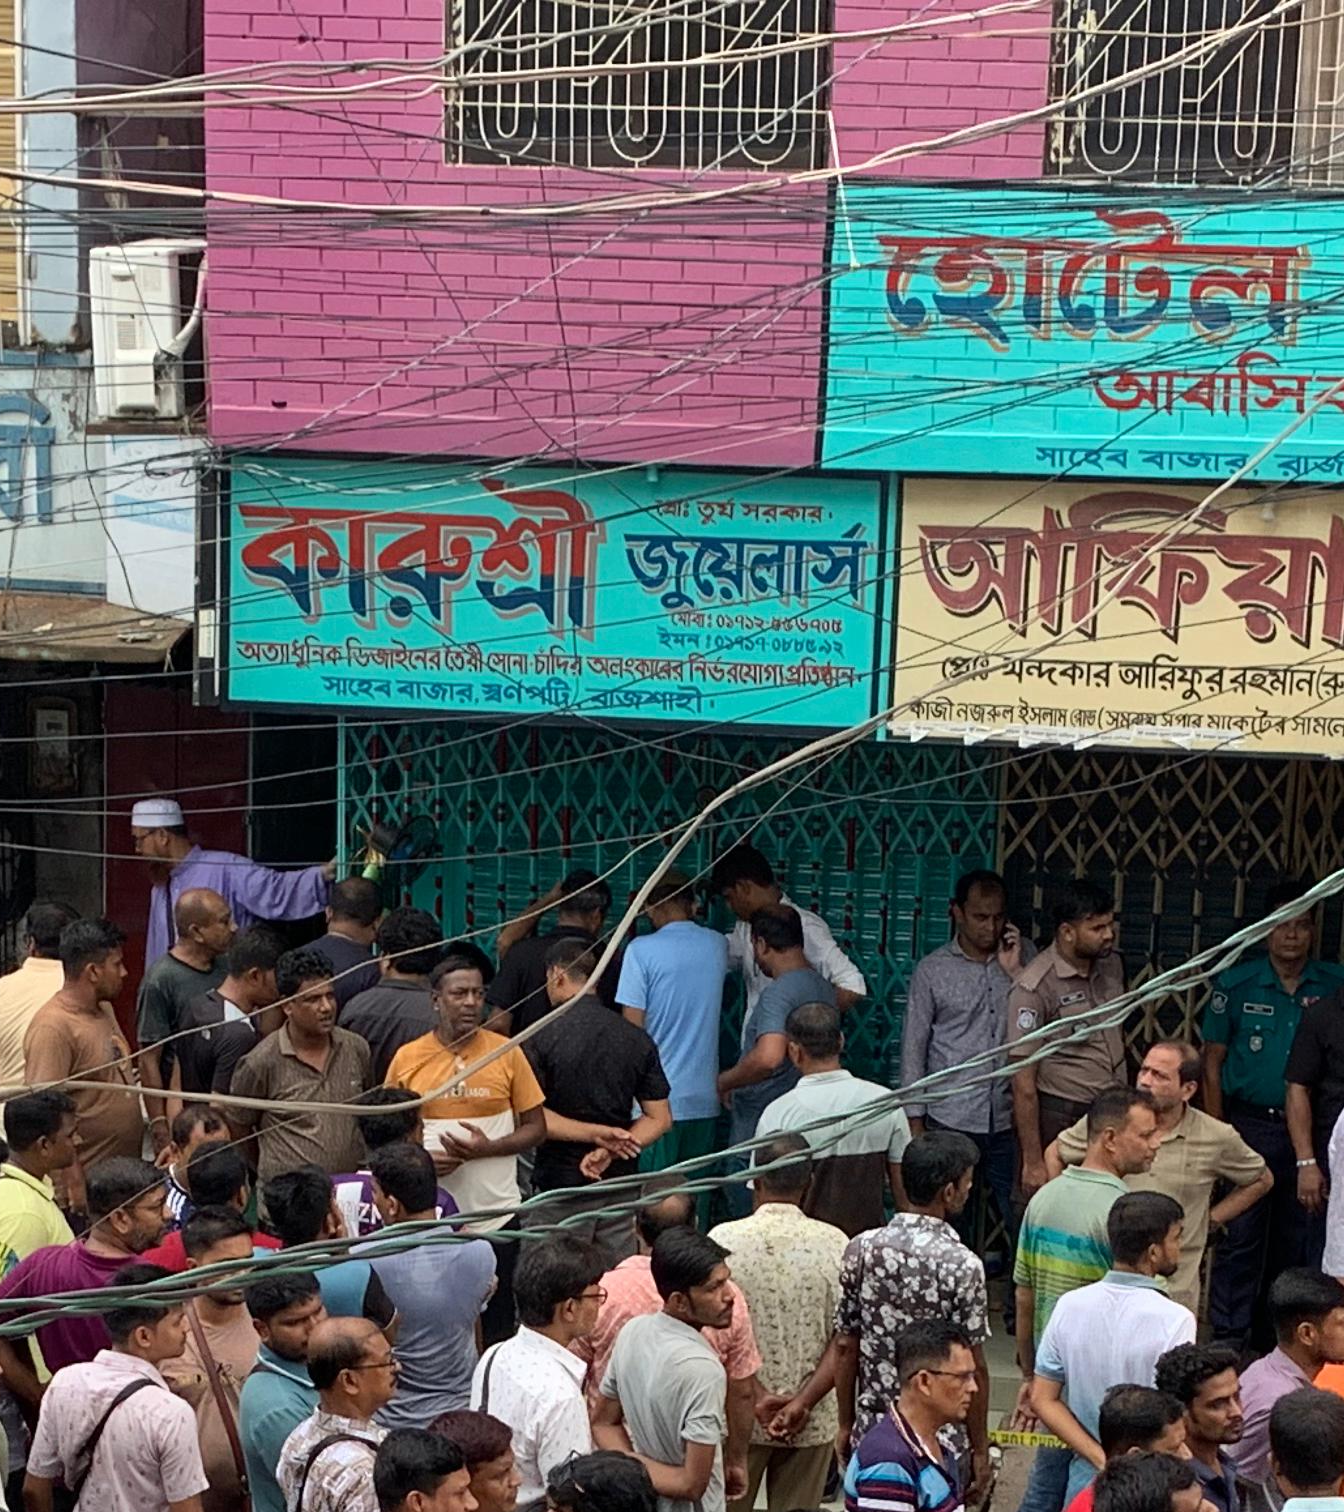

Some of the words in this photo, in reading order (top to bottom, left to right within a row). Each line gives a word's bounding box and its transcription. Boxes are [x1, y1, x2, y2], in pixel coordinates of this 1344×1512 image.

[878, 209, 1313, 351] হোটেল
[1036, 447, 1128, 469] সাহেব
[239, 478, 605, 641] কারুশ্রী
[623, 523, 874, 612] জুয়েলার্স
[321, 675, 391, 699] সাহেব
[1118, 653, 1224, 701] আরিফুর
[1229, 667, 1315, 697] রহমান
[910, 696, 954, 722] কাজী
[956, 702, 1014, 724] নজরুল
[1018, 697, 1068, 726] ইসলাম
